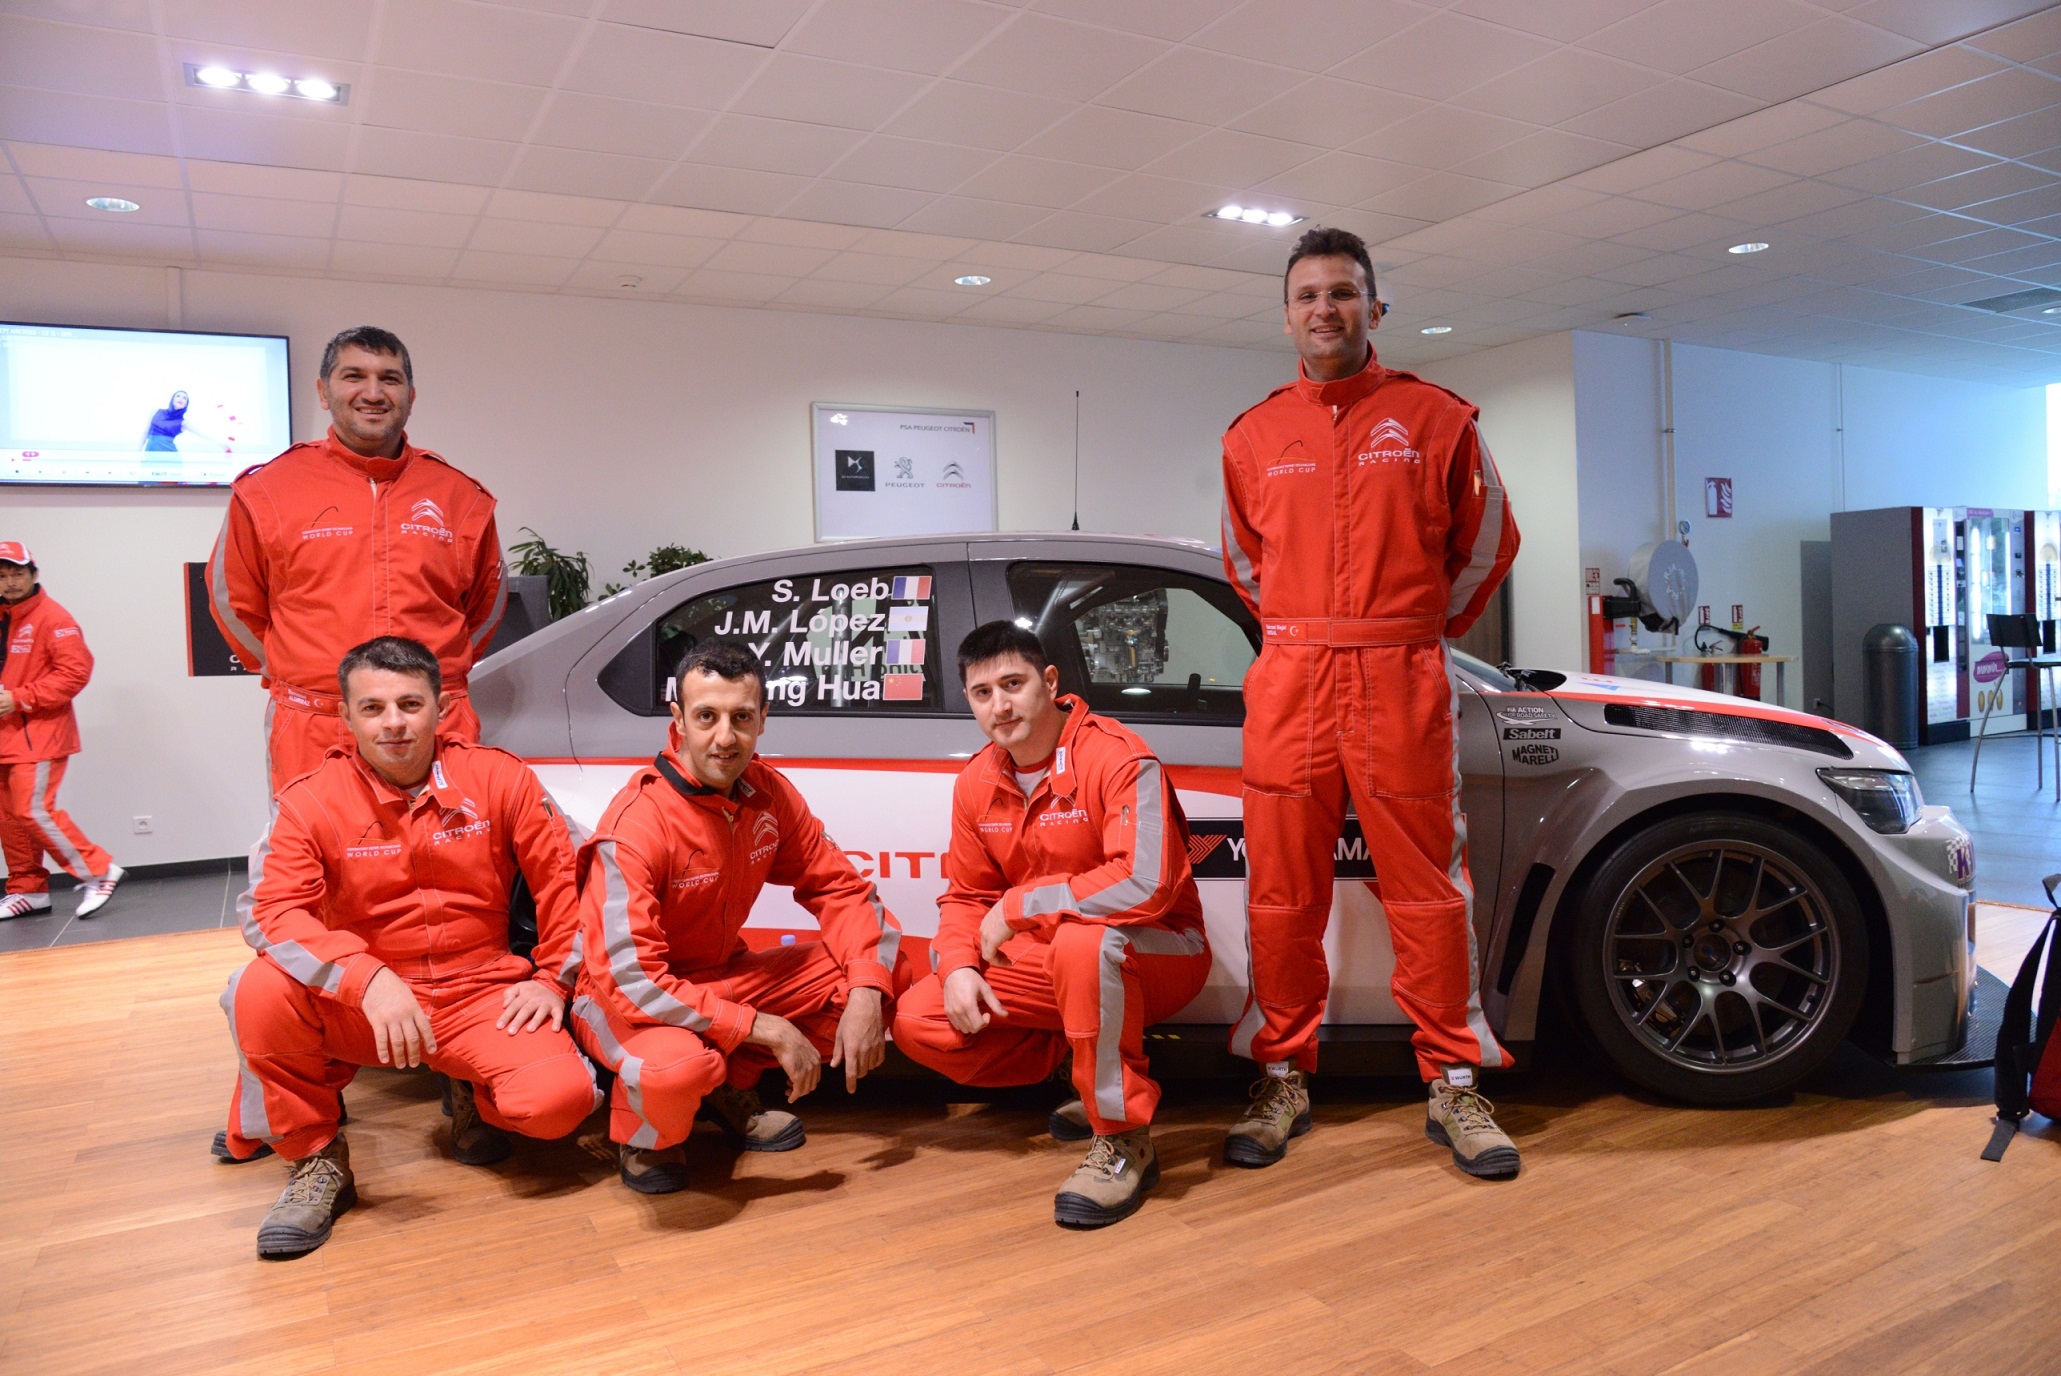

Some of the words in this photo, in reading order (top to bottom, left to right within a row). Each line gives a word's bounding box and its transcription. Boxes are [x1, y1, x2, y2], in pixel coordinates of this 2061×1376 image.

[913, 424, 943, 432] PEUGEOT
[1358, 457, 1421, 467] RACING
[1267, 468, 1295, 477] WORLD
[302, 532, 332, 541] WORLD
[401, 530, 453, 543] RACING
[772, 579, 800, 603] S.
[811, 577, 890, 601] Loeb
[714, 610, 778, 635] J.M.
[790, 608, 886, 638] López
[783, 640, 883, 667] Muller
[818, 674, 880, 700] Hua
[1509, 728, 1556, 739] Sabelt
[1040, 817, 1089, 827] RACING
[384, 848, 402, 856] CUP
[672, 879, 700, 889] WORLD
[703, 876, 720, 885] CUP
